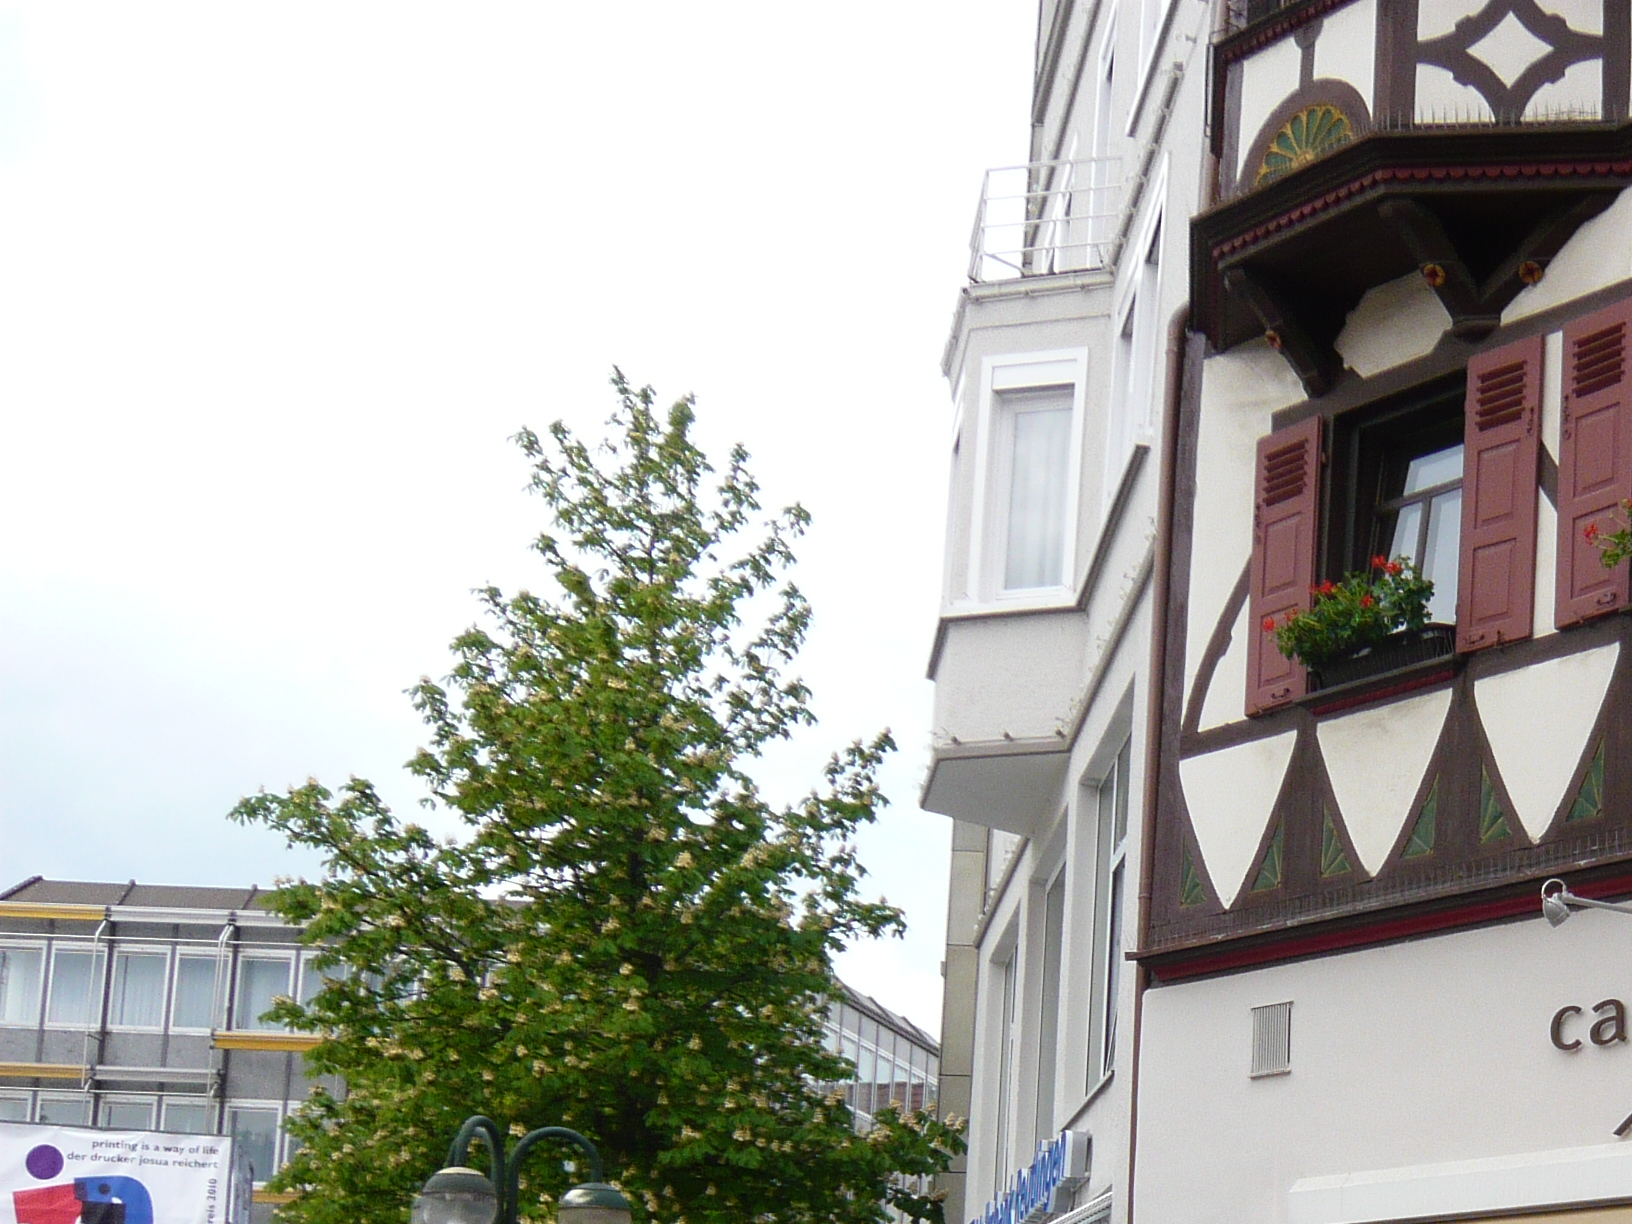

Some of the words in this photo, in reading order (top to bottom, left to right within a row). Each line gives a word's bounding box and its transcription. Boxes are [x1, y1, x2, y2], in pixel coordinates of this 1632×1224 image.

[92, 1139, 138, 1152] printing
[141, 1141, 150, 1151] is
[163, 1145, 185, 1155] way
[188, 1144, 200, 1154] of
[202, 1145, 219, 1155] life
[67, 1151, 87, 1161] der
[90, 1152, 136, 1164] drucker
[138, 1155, 169, 1166] josua
[172, 1158, 219, 1169] reichert
[206, 1178, 218, 1201] 2010
